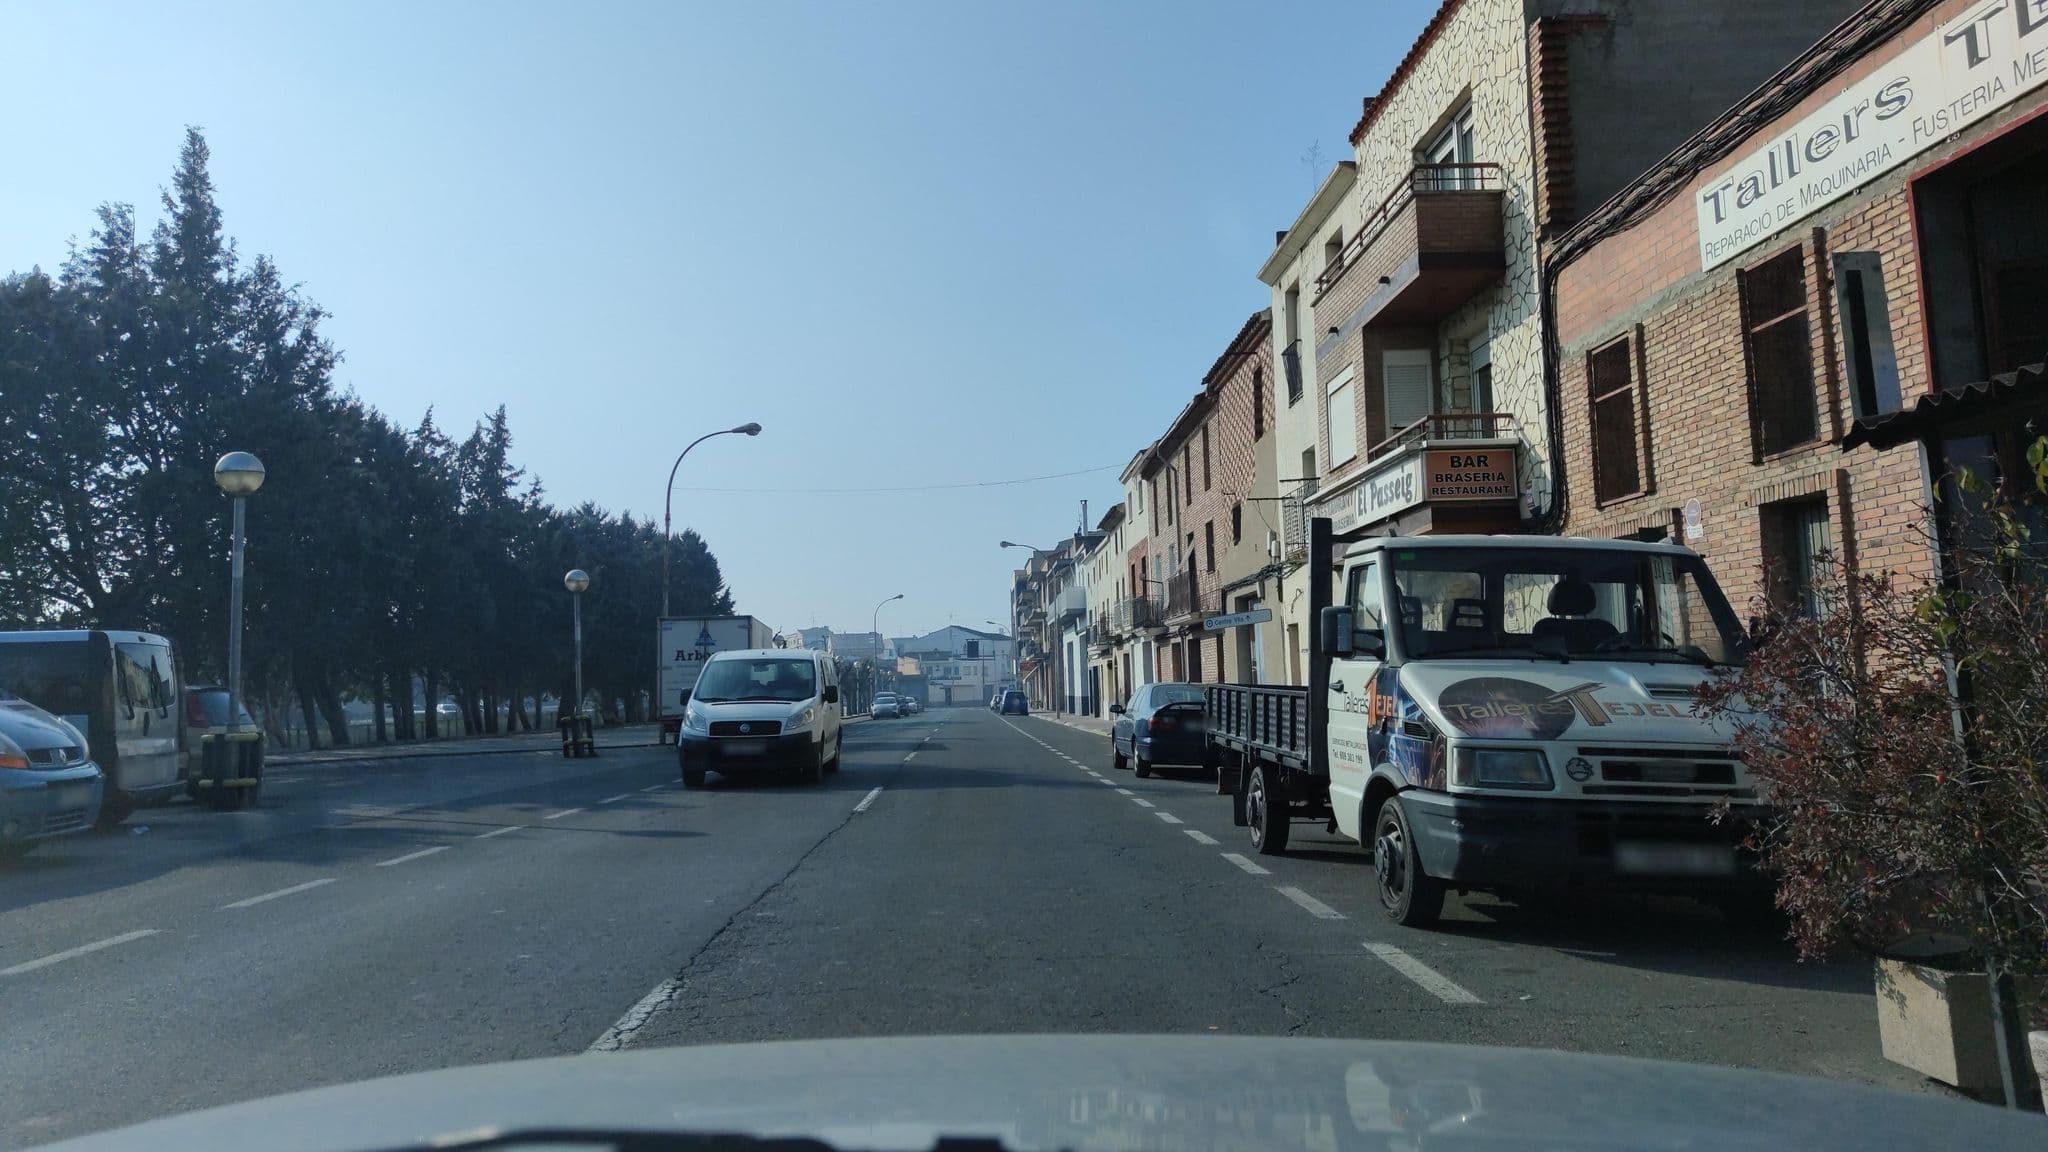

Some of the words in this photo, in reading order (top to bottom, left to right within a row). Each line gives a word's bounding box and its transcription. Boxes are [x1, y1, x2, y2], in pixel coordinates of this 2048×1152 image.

[1703, 75, 1914, 225] Tallers
[1776, 198, 1796, 220] DE
[1799, 143, 1893, 209] MAQUINARIA
[1912, 76, 2006, 145] FUSTERIA
[1450, 455, 1490, 468] BAR
[1435, 471, 1506, 483] BRASERIA
[1357, 488, 1369, 516] El
[1370, 465, 1414, 511] Passeig
[1432, 485, 1511, 496] RESTAURANT
[1447, 700, 1574, 721] Talleres
